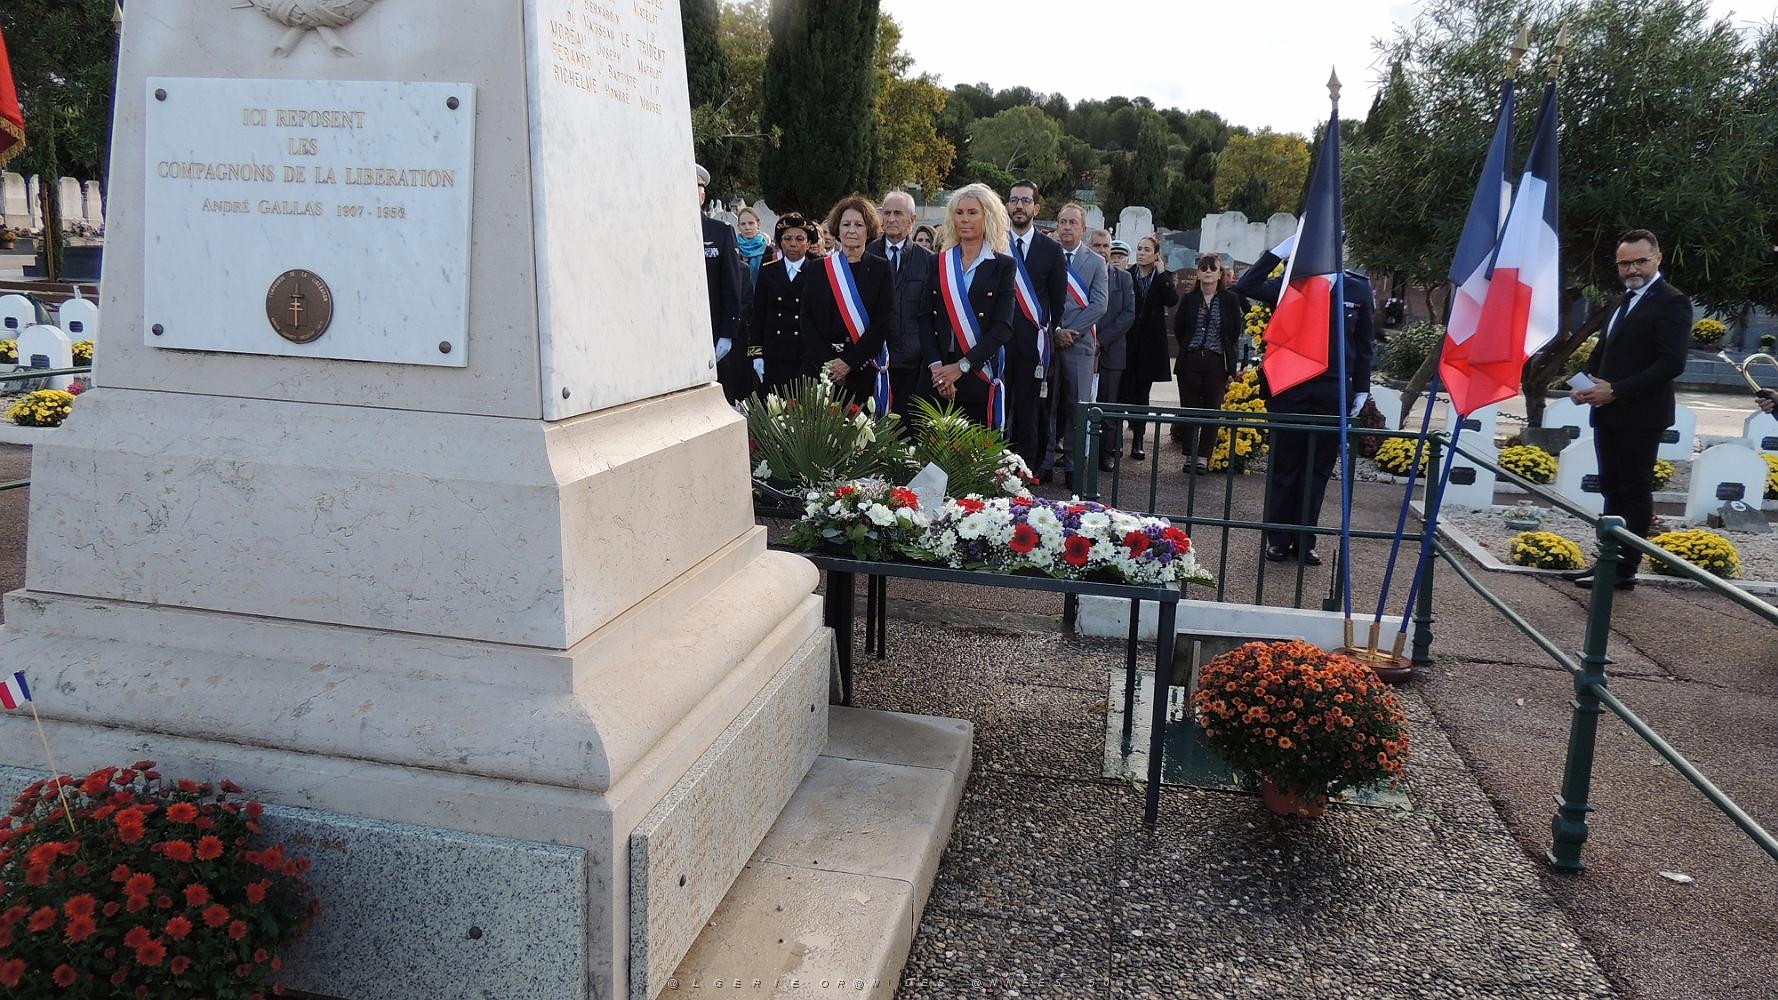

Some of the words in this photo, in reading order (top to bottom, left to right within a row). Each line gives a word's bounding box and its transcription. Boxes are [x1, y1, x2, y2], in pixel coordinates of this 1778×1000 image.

[243, 109, 267, 126] ICI
[276, 110, 366, 129] REPOSENT
[287, 138, 318, 155] LES
[158, 160, 275, 183] COMPAGNONS
[283, 166, 307, 183] DE
[315, 167, 337, 184] LA
[257, 200, 324, 216] GALLAS
